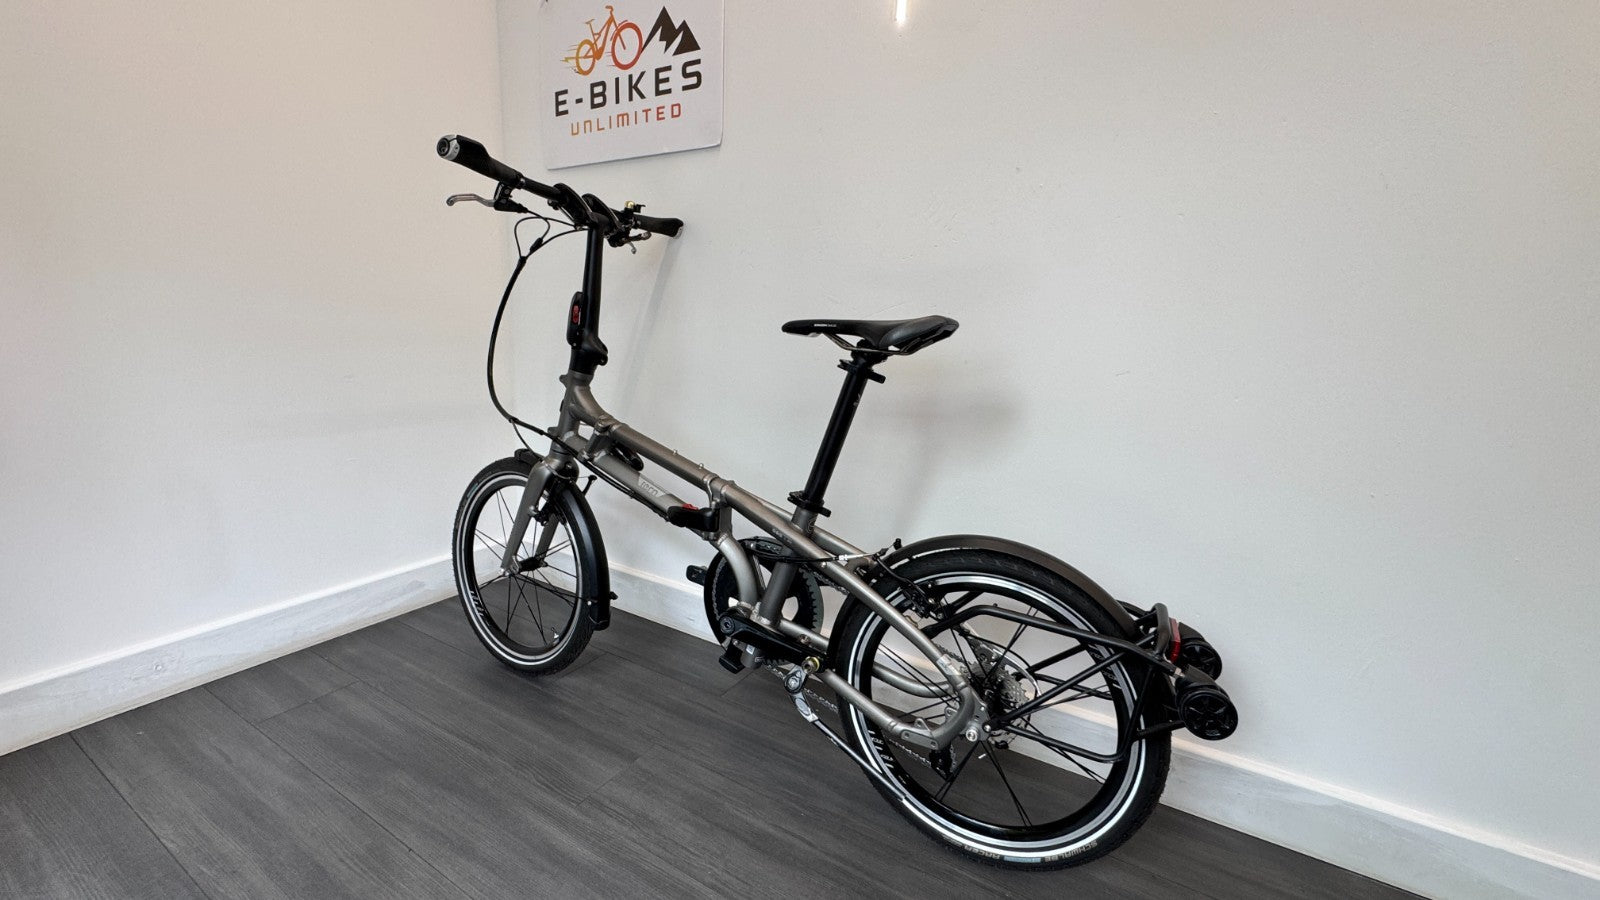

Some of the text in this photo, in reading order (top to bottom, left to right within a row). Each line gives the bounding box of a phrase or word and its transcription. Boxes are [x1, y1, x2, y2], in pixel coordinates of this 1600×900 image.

[555, 58, 702, 117] E-BIKES
[571, 103, 682, 136] UNLIMITED
[1044, 840, 1098, 862] SCHWALBE
